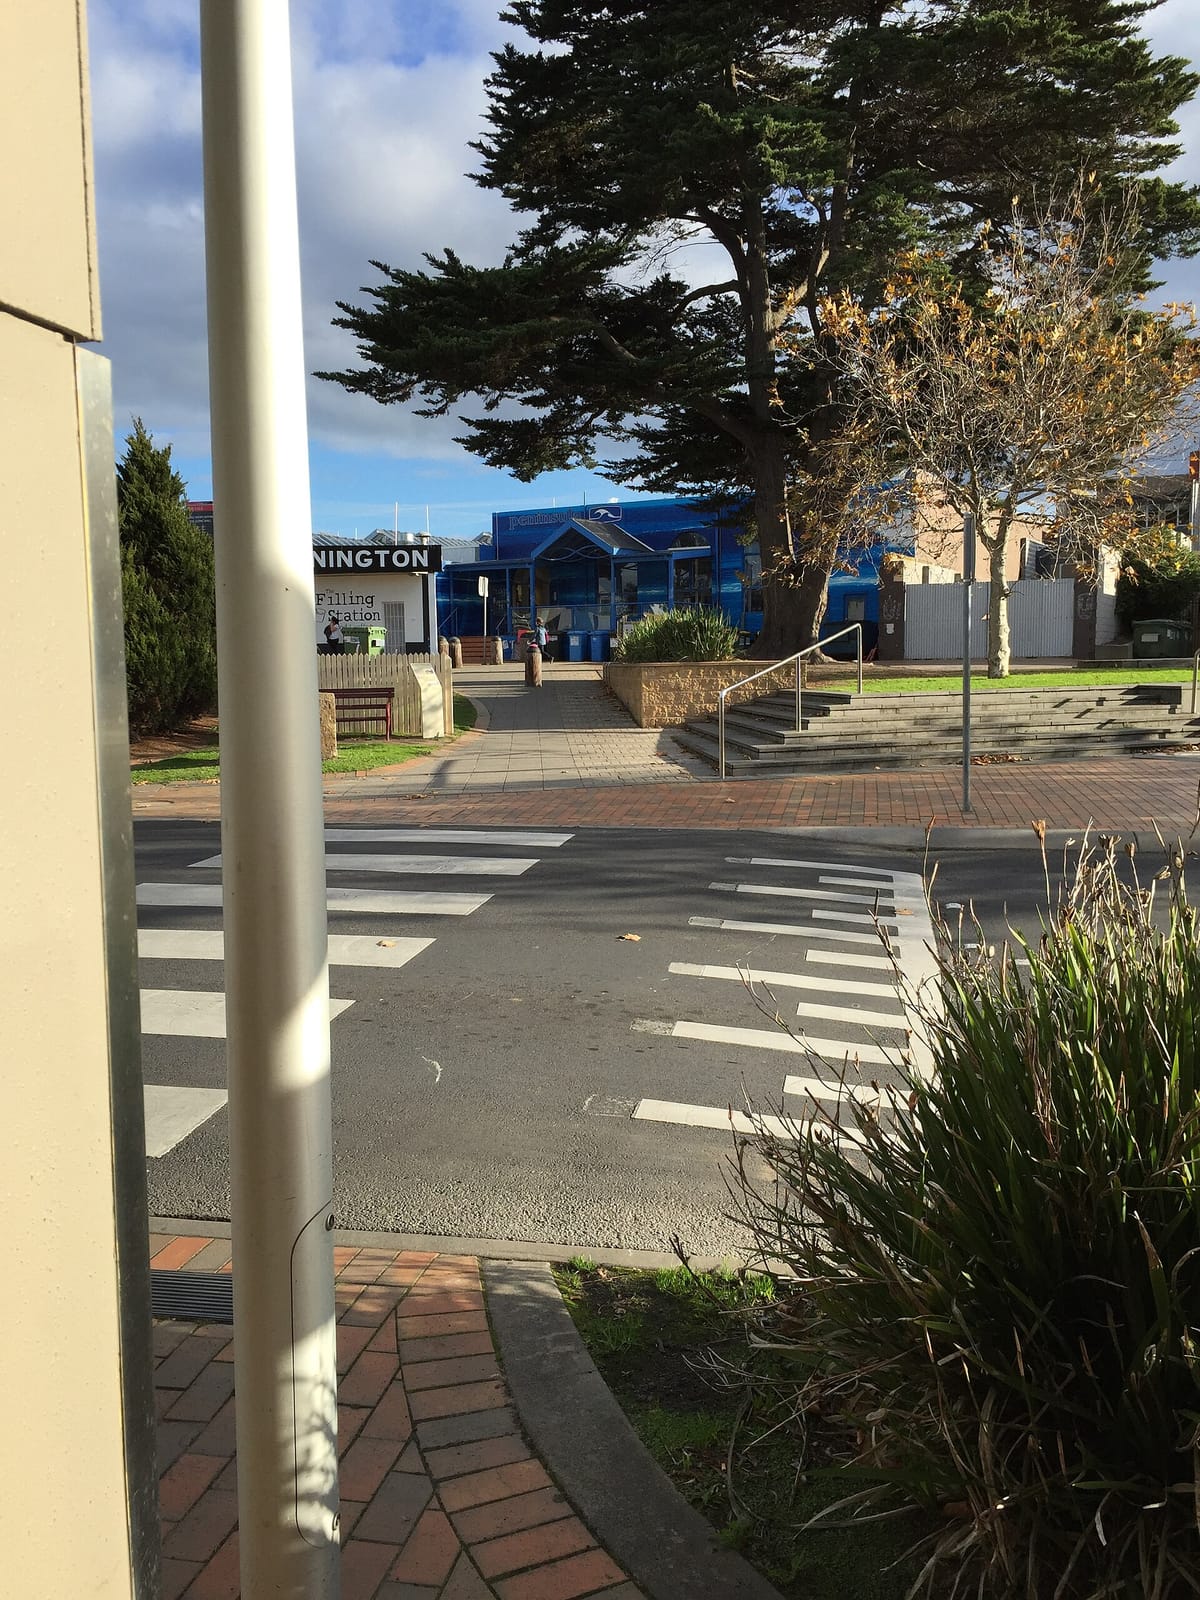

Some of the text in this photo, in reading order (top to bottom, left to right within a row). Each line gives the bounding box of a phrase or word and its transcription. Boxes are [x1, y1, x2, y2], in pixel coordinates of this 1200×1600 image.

[313, 549, 429, 568] NINGTON
[315, 590, 375, 608] Filling
[328, 608, 380, 622] Station
